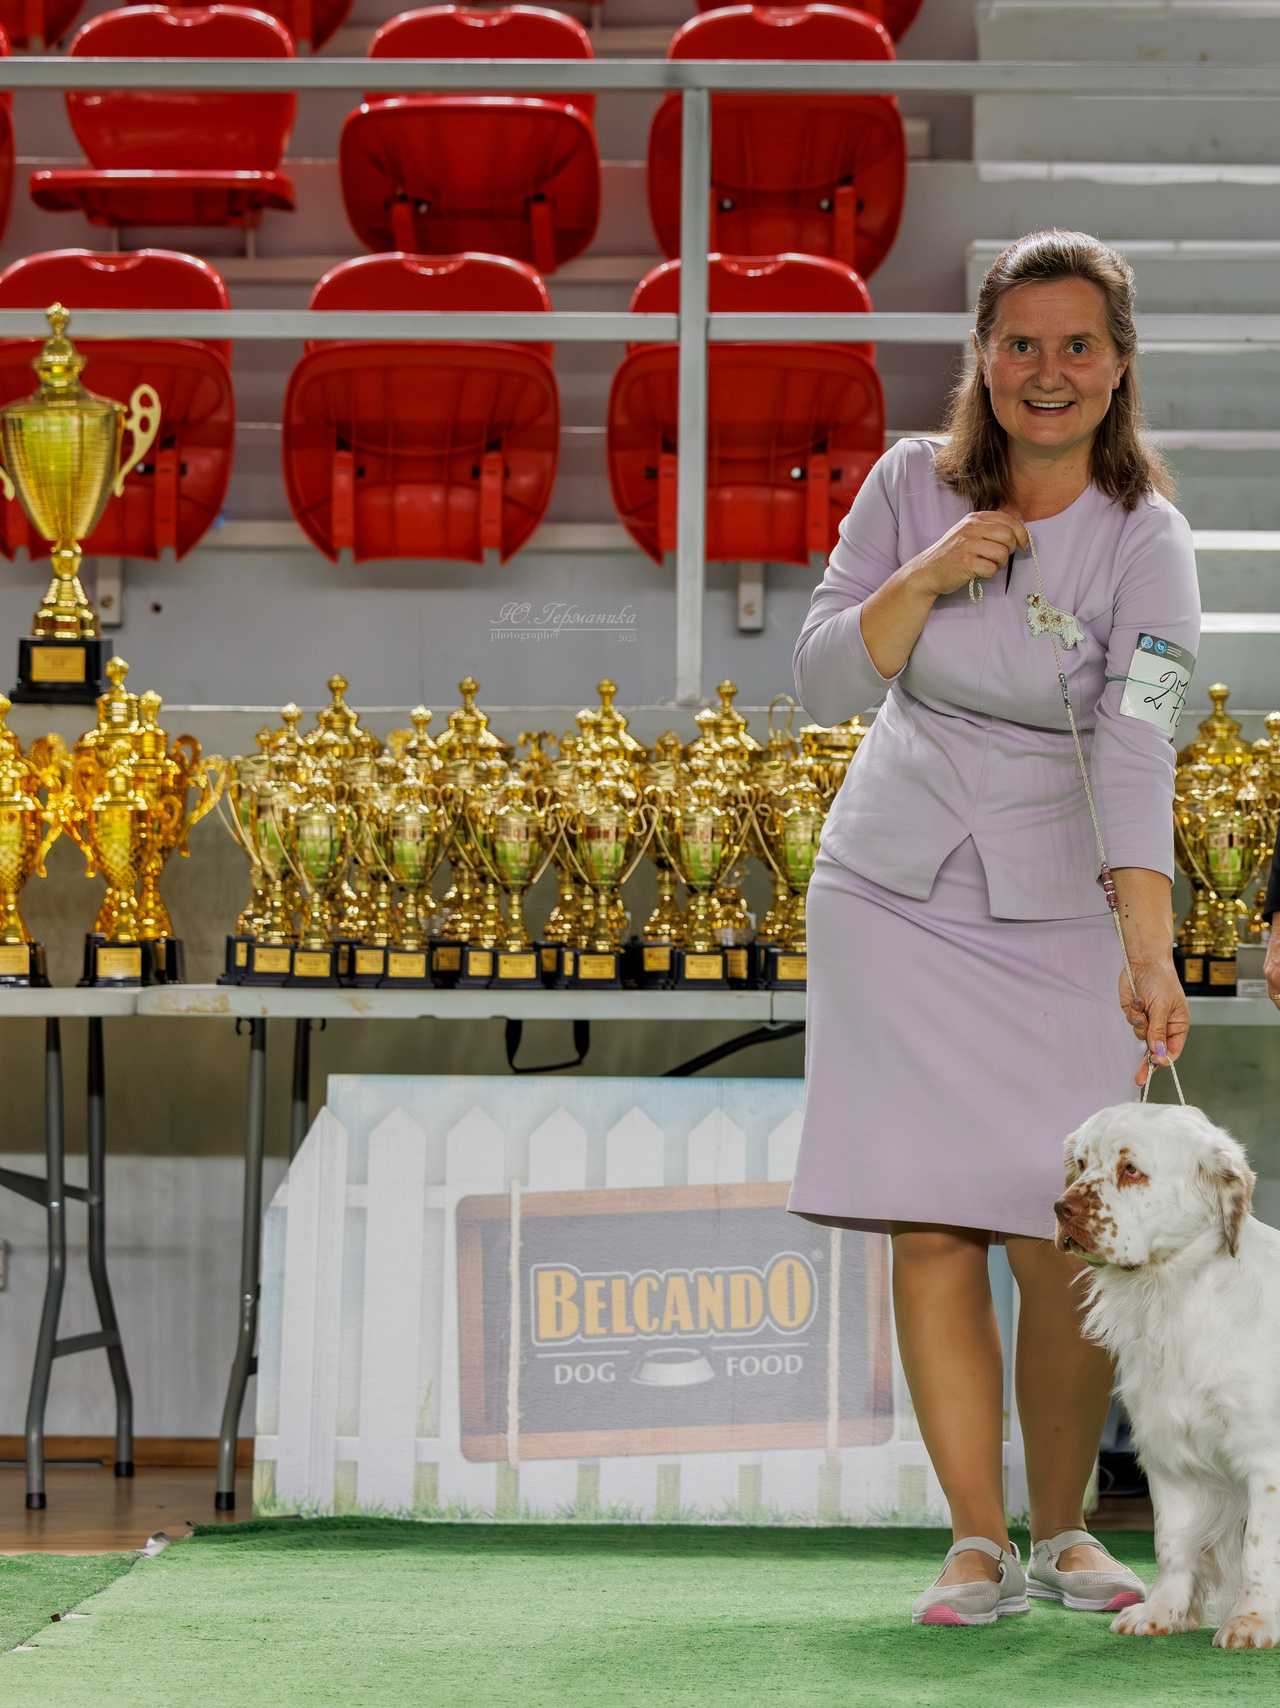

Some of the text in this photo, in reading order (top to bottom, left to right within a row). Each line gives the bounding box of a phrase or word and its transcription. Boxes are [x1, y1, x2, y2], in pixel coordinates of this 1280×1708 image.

[537, 1258, 812, 1340] BELCANDO
[554, 1354, 804, 1385] DOG FOOD
